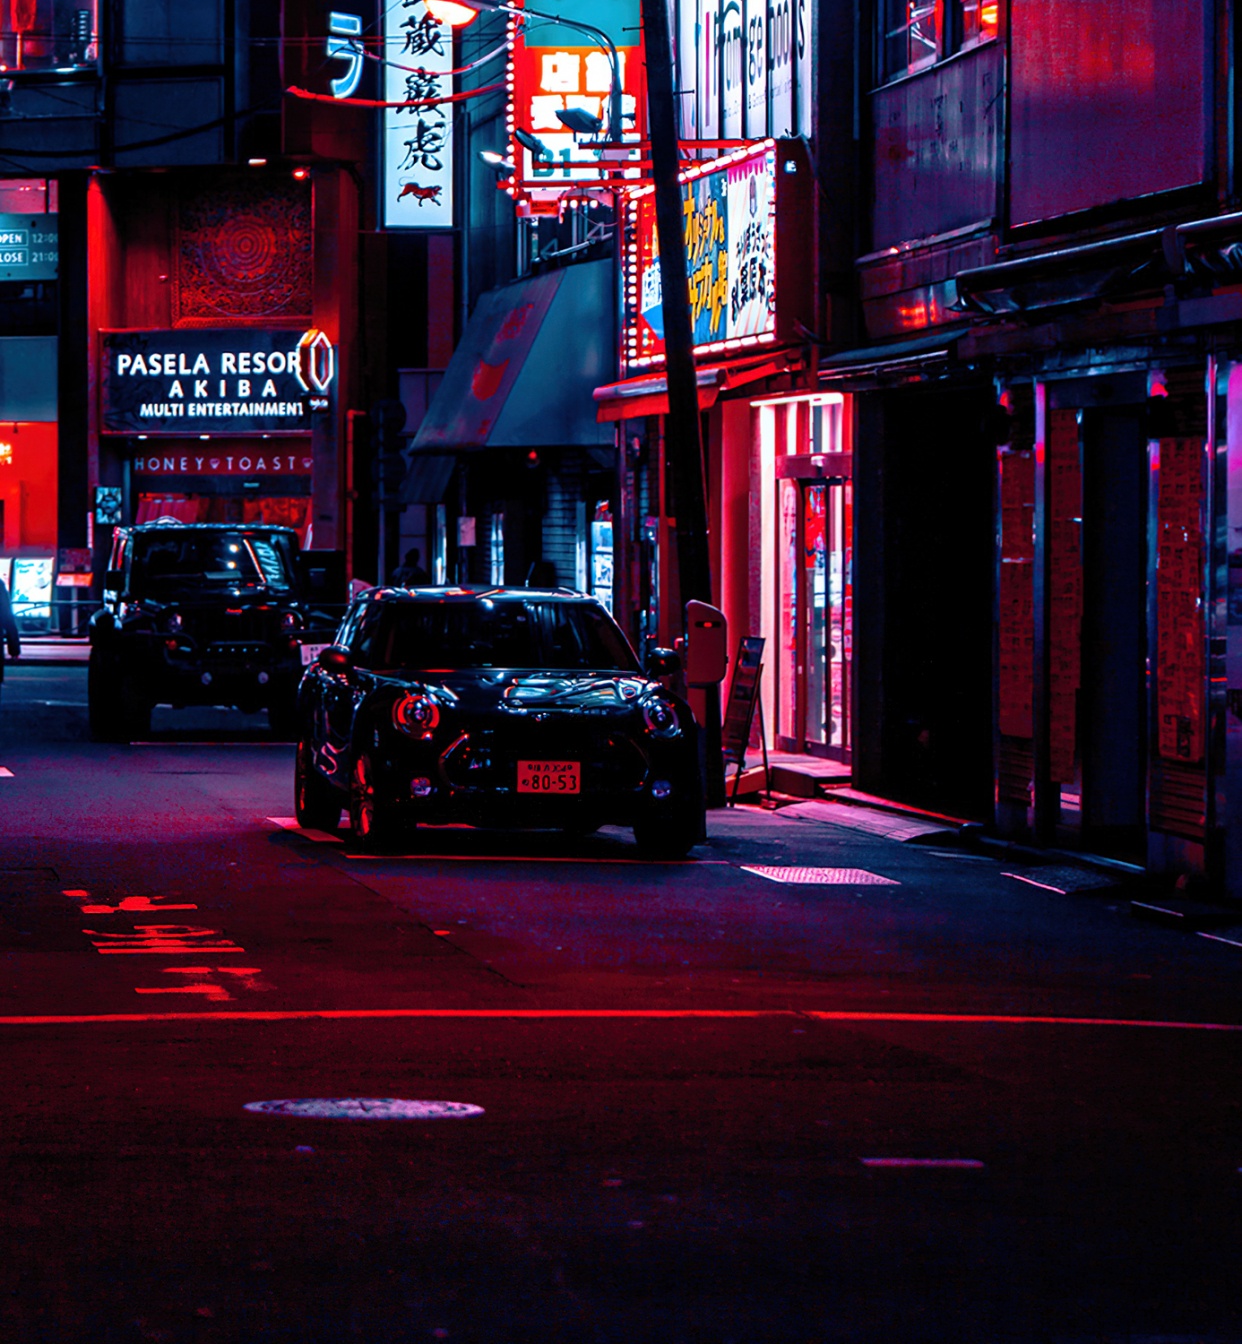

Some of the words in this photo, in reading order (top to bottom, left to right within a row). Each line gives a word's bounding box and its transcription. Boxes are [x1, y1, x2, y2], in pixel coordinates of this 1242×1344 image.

[0, 252, 23, 263] LOSE
[117, 353, 210, 375] PASELA
[220, 351, 302, 374] RESOR
[168, 379, 278, 398] AKIBA
[140, 403, 184, 417] MULTI
[134, 457, 205, 470] HONEY
[225, 456, 296, 470] TOAST
[531, 774, 577, 791] 80-53
